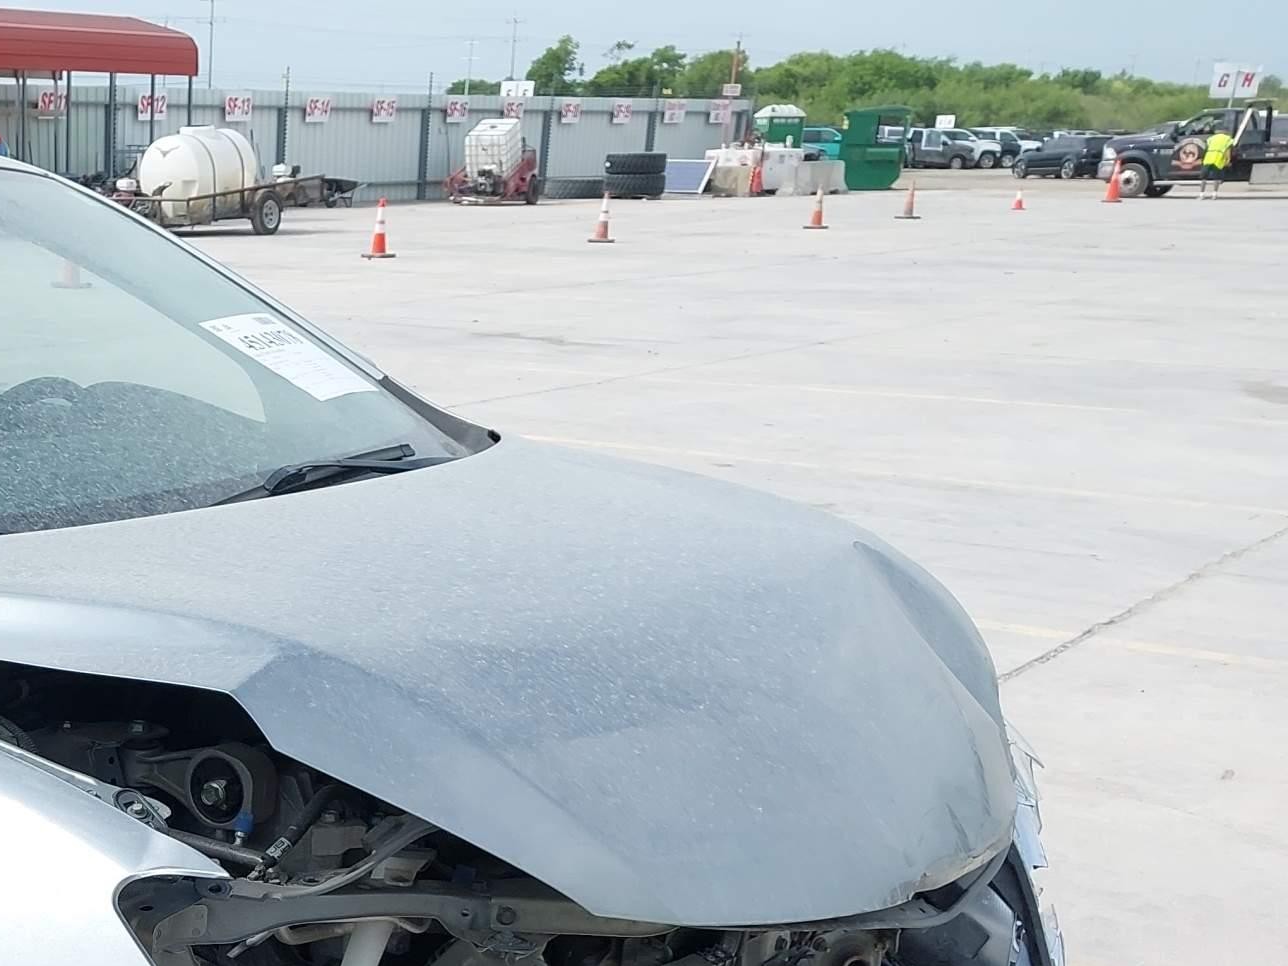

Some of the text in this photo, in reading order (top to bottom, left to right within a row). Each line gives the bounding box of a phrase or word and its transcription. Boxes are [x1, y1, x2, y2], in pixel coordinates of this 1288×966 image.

[1218, 73, 1230, 88] G
[1241, 72, 1255, 88] H
[41, 91, 69, 112] SF11
[140, 95, 166, 113] SF12
[227, 97, 252, 115] SF-13
